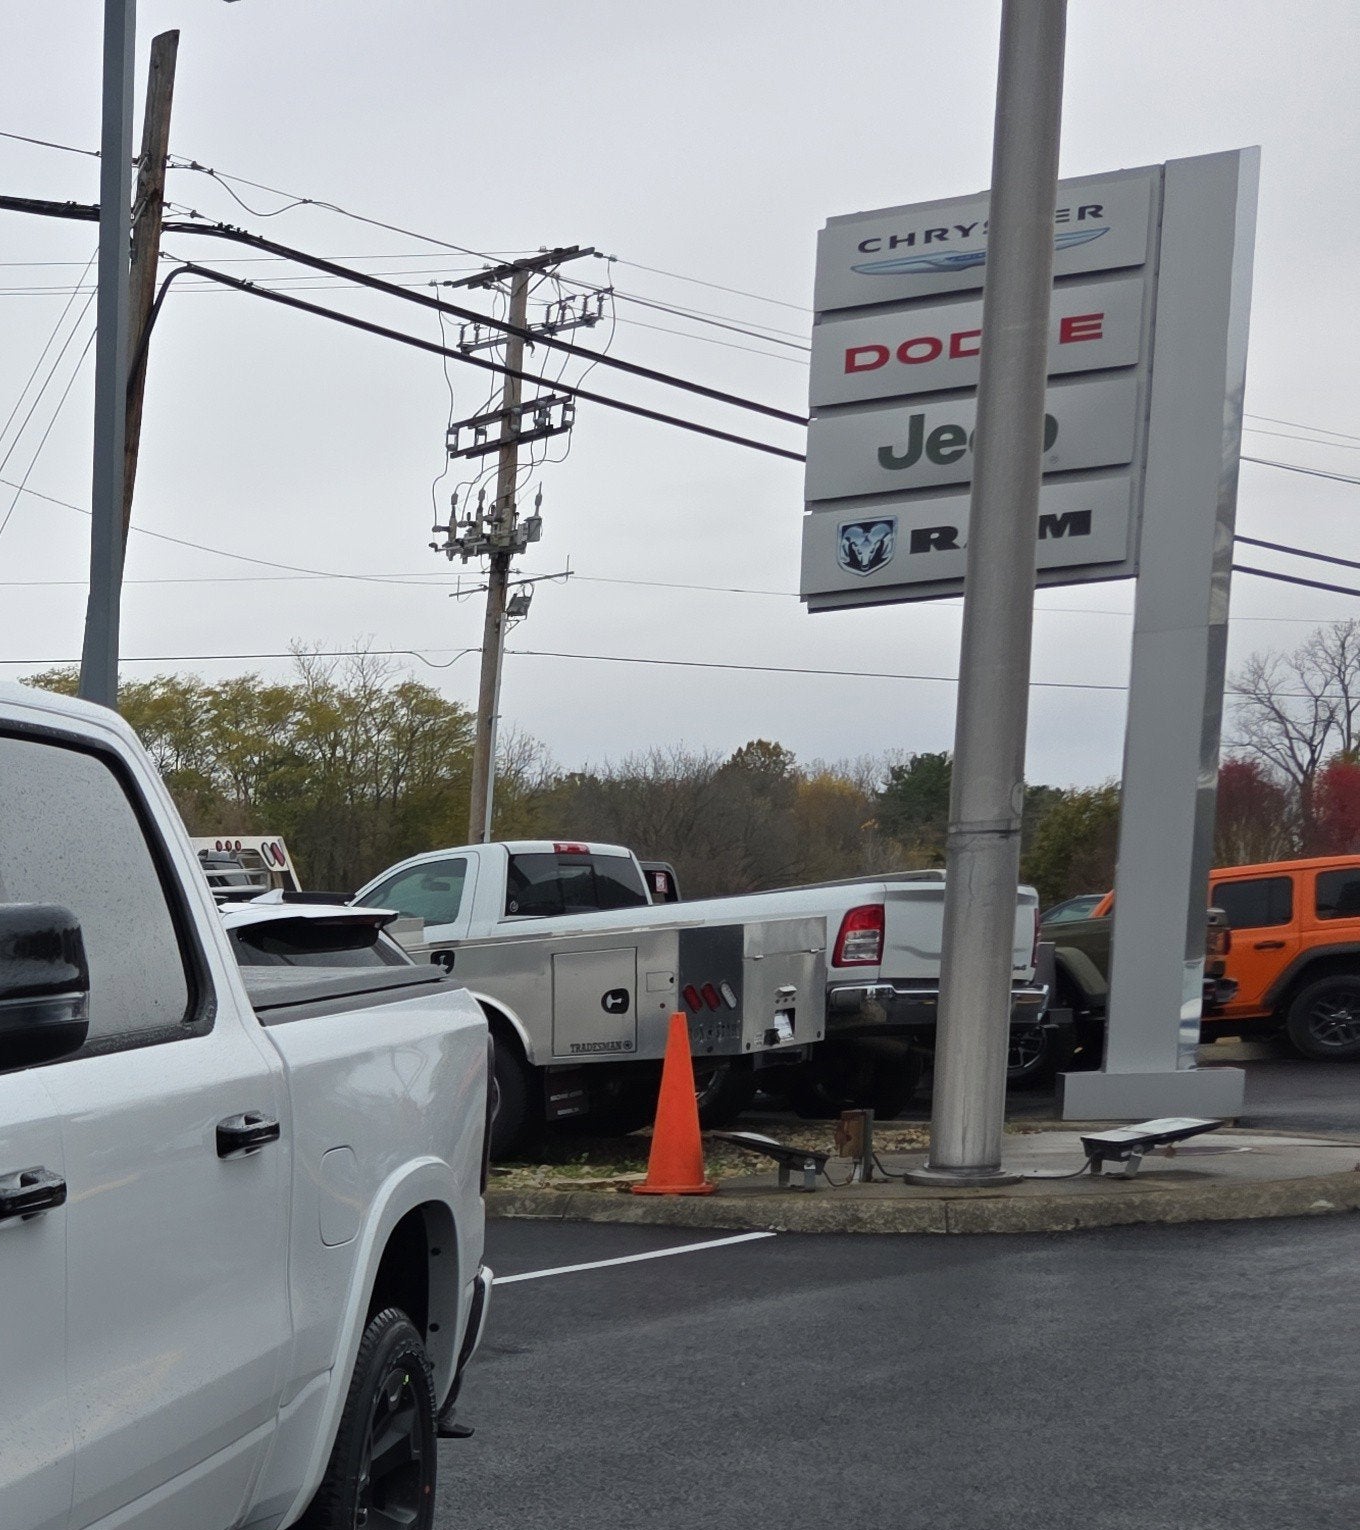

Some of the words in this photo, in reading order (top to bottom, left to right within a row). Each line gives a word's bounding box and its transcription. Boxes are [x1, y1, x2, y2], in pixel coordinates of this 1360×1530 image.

[857, 203, 1104, 254] CHRYER
[844, 312, 1105, 375] DODE
[877, 413, 1059, 471] Je
[908, 509, 1092, 555] RM
[570, 1040, 622, 1053] TRADESMAN
